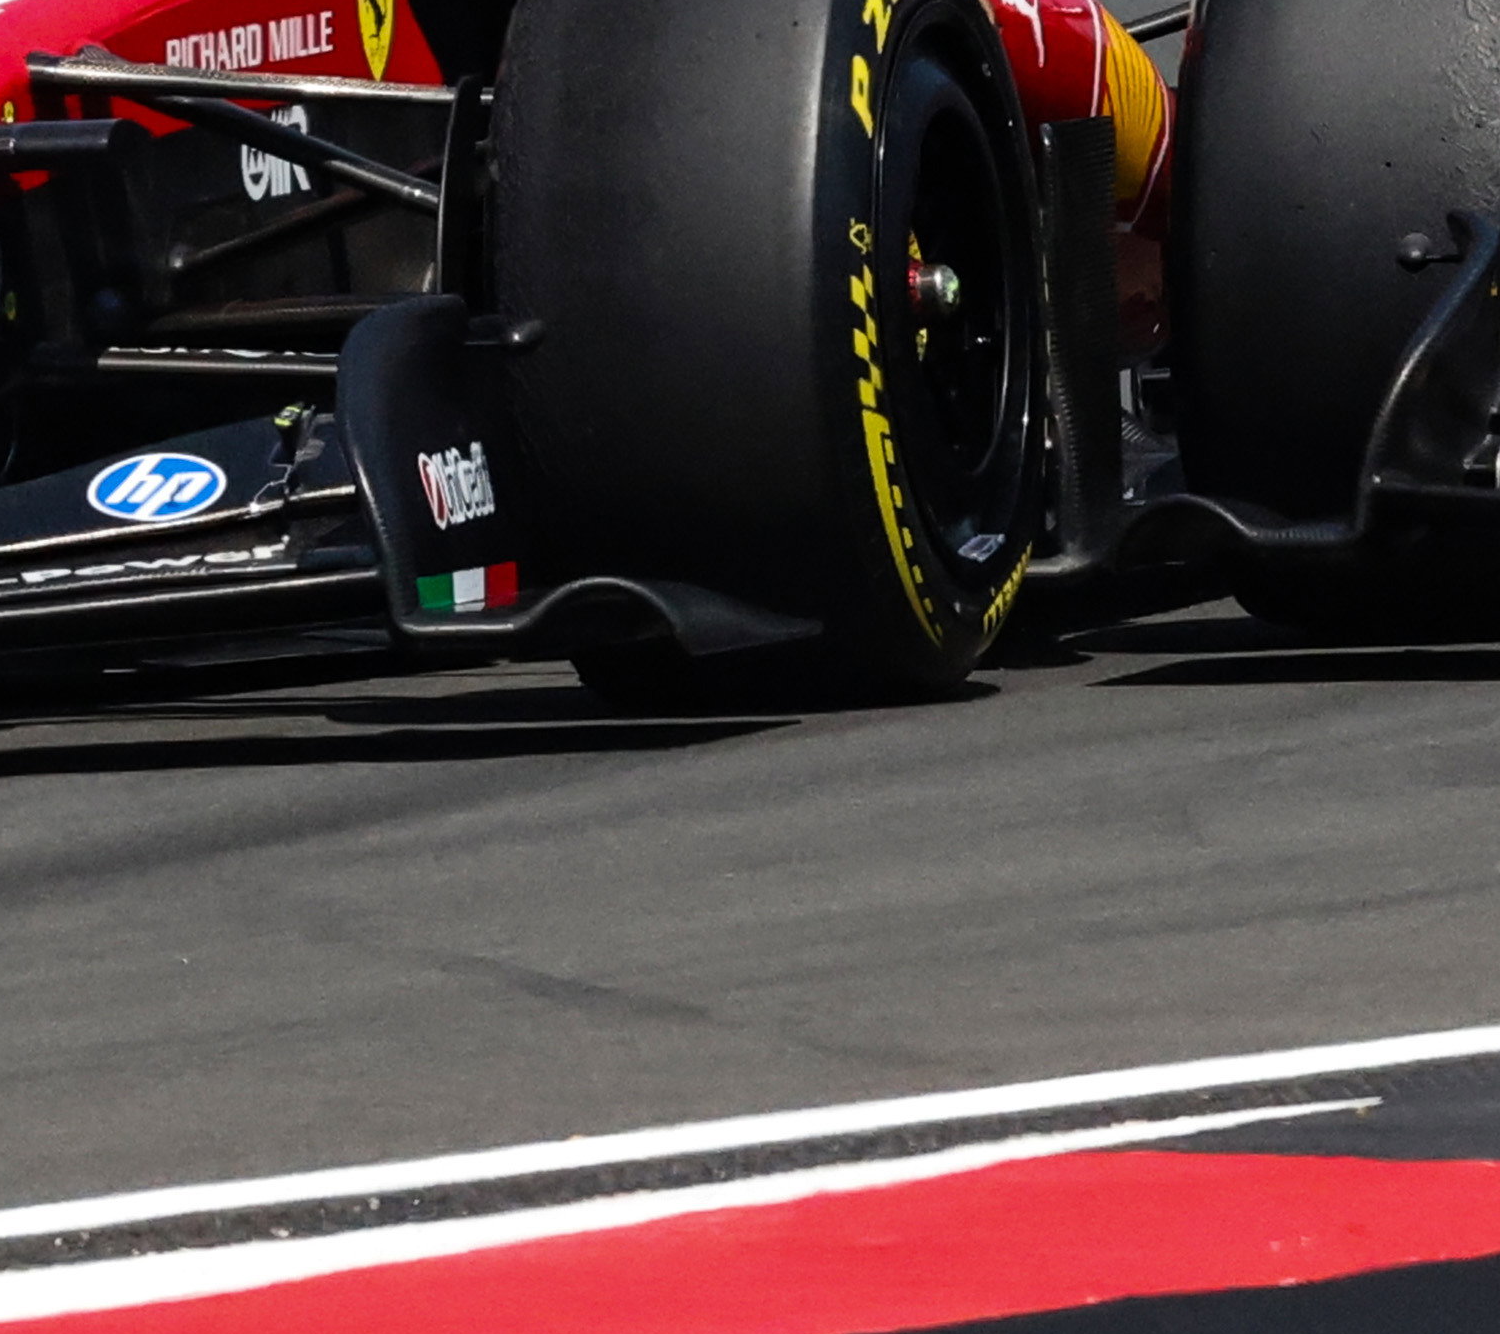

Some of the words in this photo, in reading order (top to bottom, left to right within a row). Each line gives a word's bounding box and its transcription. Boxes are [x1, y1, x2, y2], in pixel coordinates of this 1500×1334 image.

[166, 23, 264, 71] RICHARD
[268, 10, 334, 62] MILLE
[851, 54, 874, 140] P
[92, 453, 222, 522] hp
